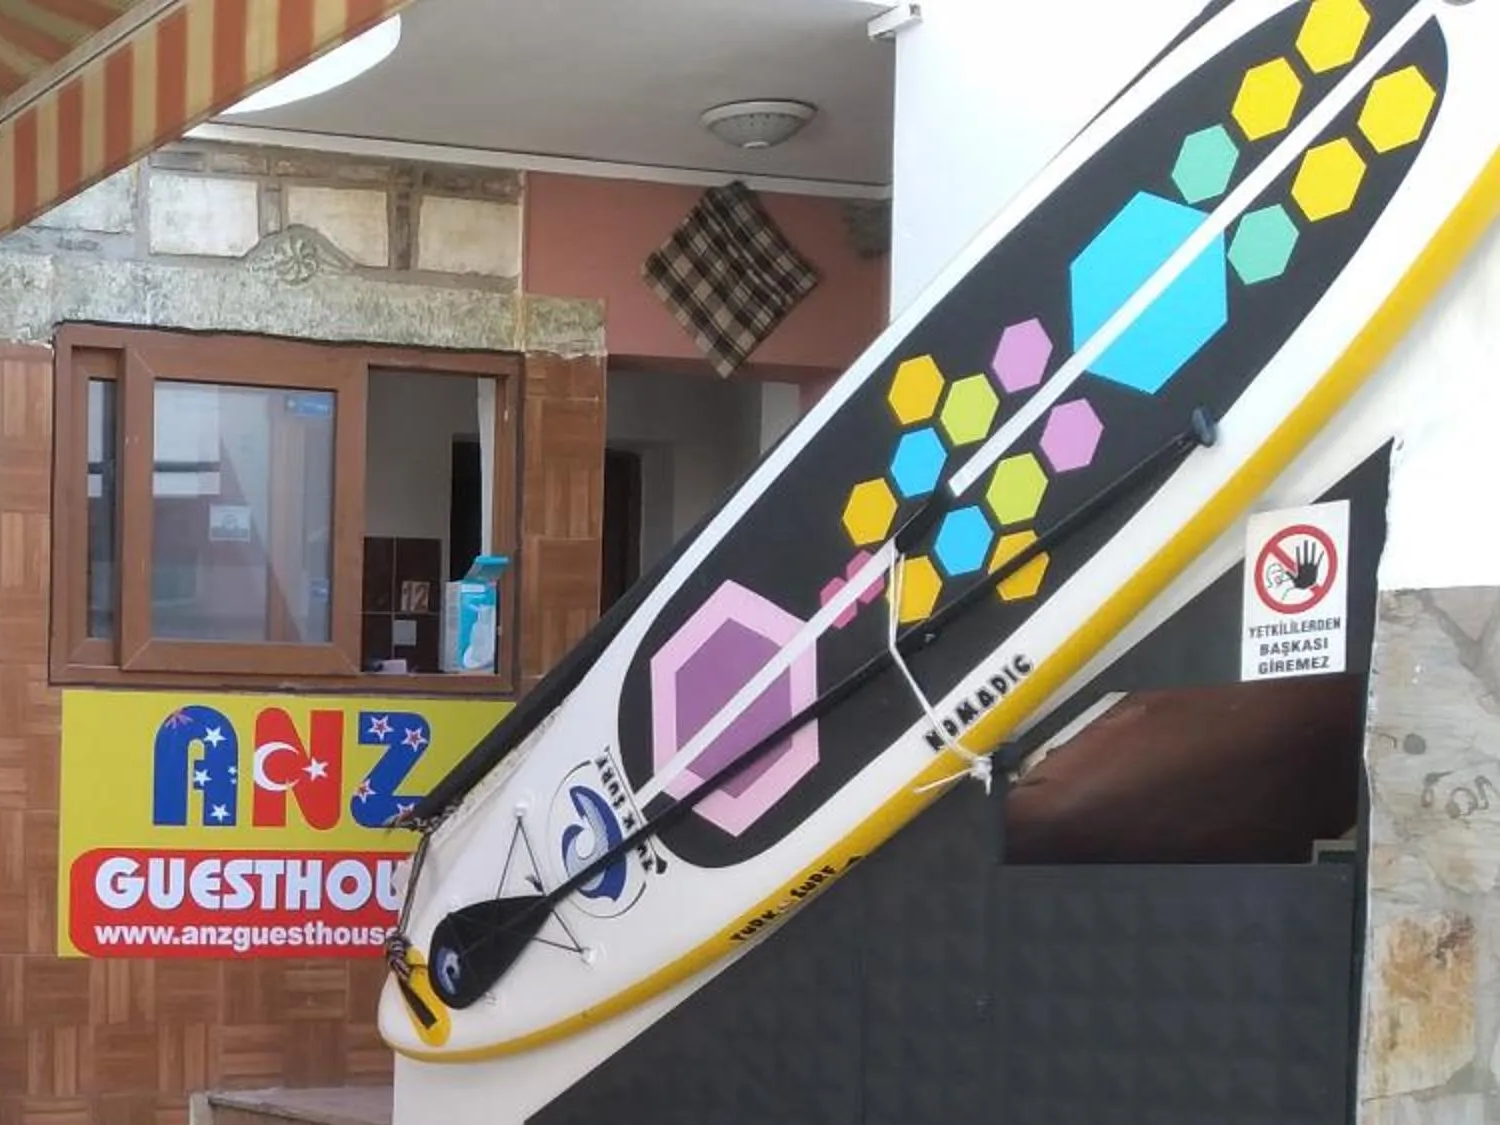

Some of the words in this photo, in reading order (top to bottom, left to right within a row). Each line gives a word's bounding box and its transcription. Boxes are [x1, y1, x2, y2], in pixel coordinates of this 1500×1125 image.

[1249, 617, 1341, 638] YETKİLİLERDEN
[1260, 638, 1329, 656] BAŞKASI
[1258, 656, 1330, 675] GİREMEZ
[924, 655, 1031, 751] NOMADIC
[152, 705, 431, 830] ANZ
[621, 812, 654, 873] TUK
[95, 857, 402, 911] GUESTHOU
